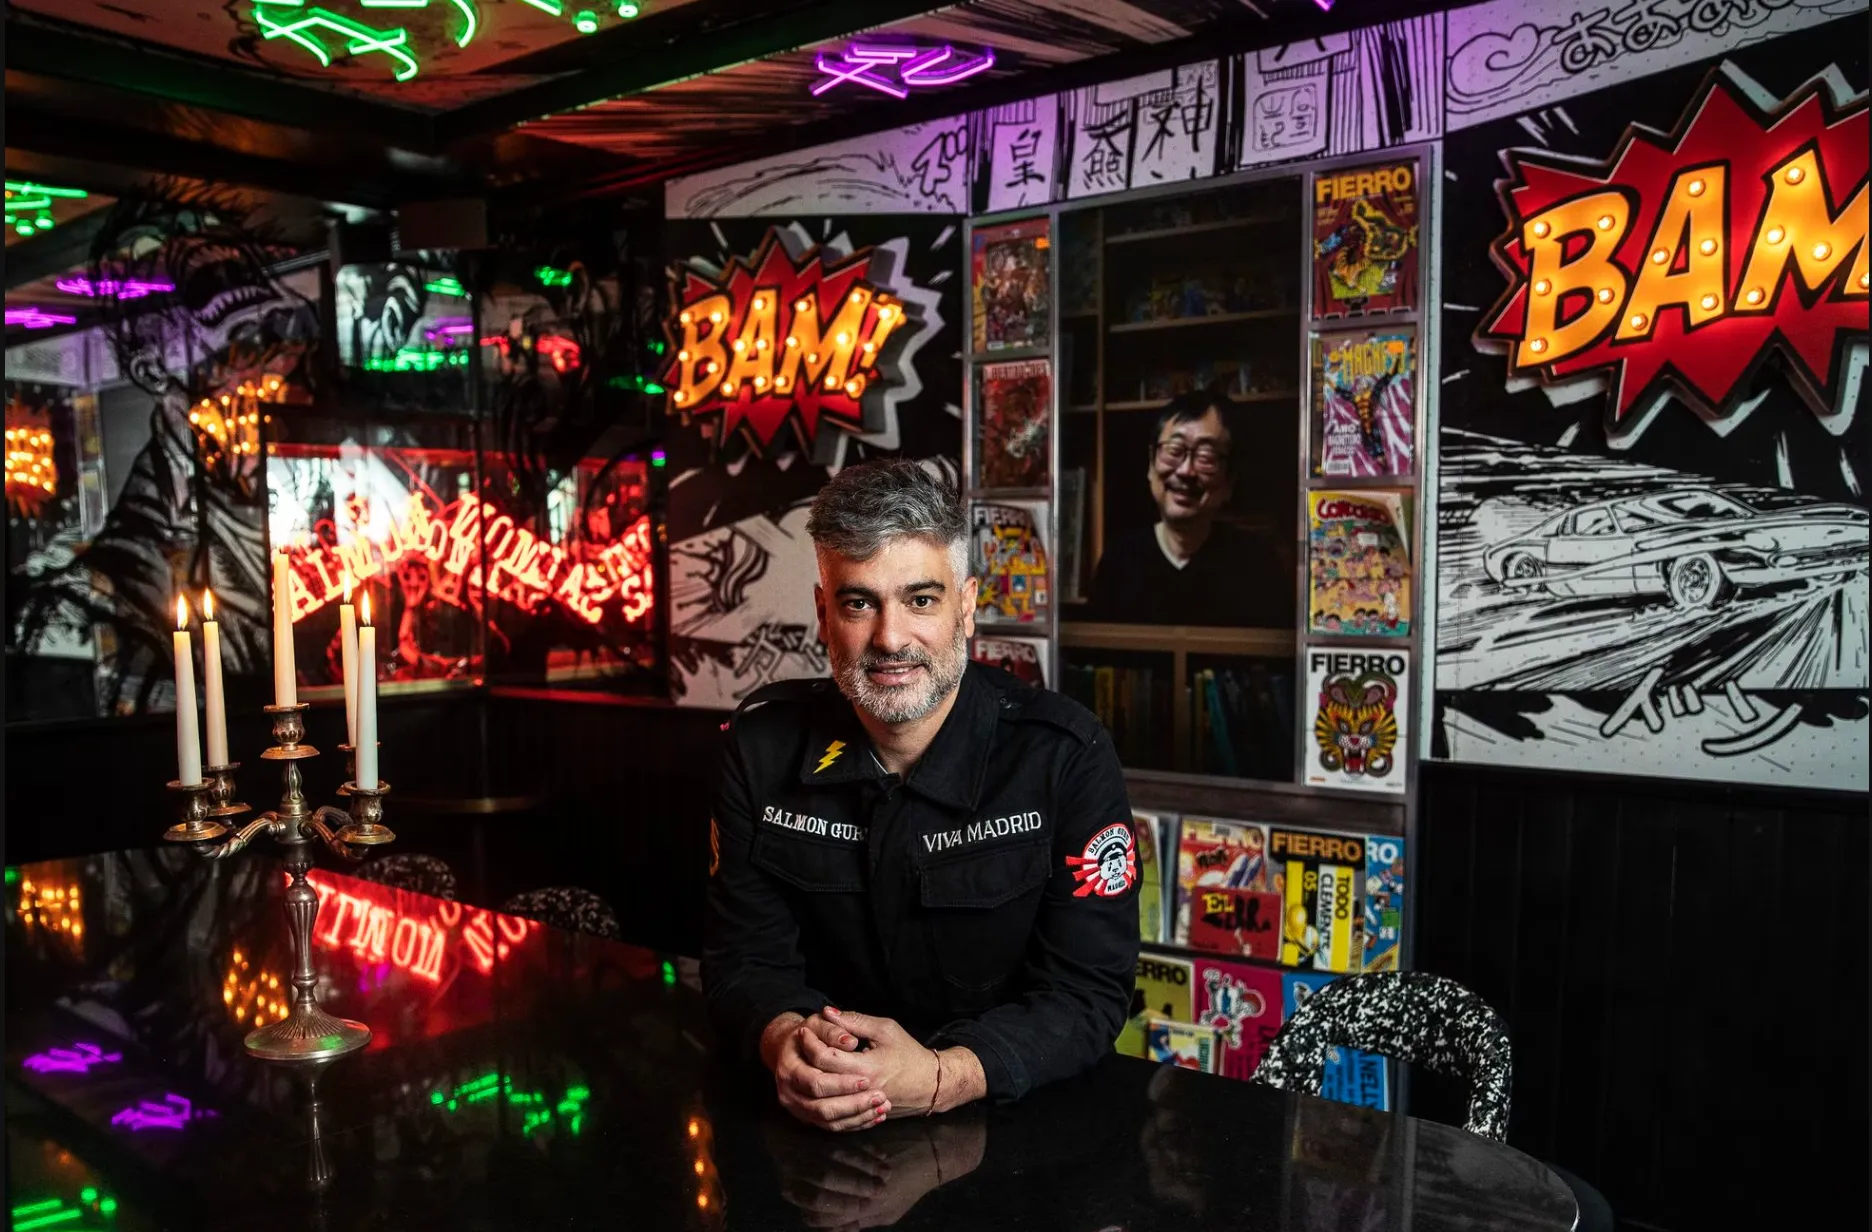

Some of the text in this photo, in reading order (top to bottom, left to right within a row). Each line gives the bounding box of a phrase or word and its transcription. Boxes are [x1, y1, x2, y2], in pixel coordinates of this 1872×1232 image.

[1315, 167, 1411, 203] FIERRO
[673, 285, 906, 410] BAM!
[975, 640, 1037, 664] FIERRO
[1311, 653, 1406, 676] FIERRO
[762, 806, 869, 842] SALMON GUR
[922, 811, 1042, 853] VIVA MADRID
[1087, 828, 1115, 854] SALMON
[1271, 831, 1363, 863] FIERRO
[1201, 891, 1236, 915] EL
[1335, 875, 1351, 921] TODO
